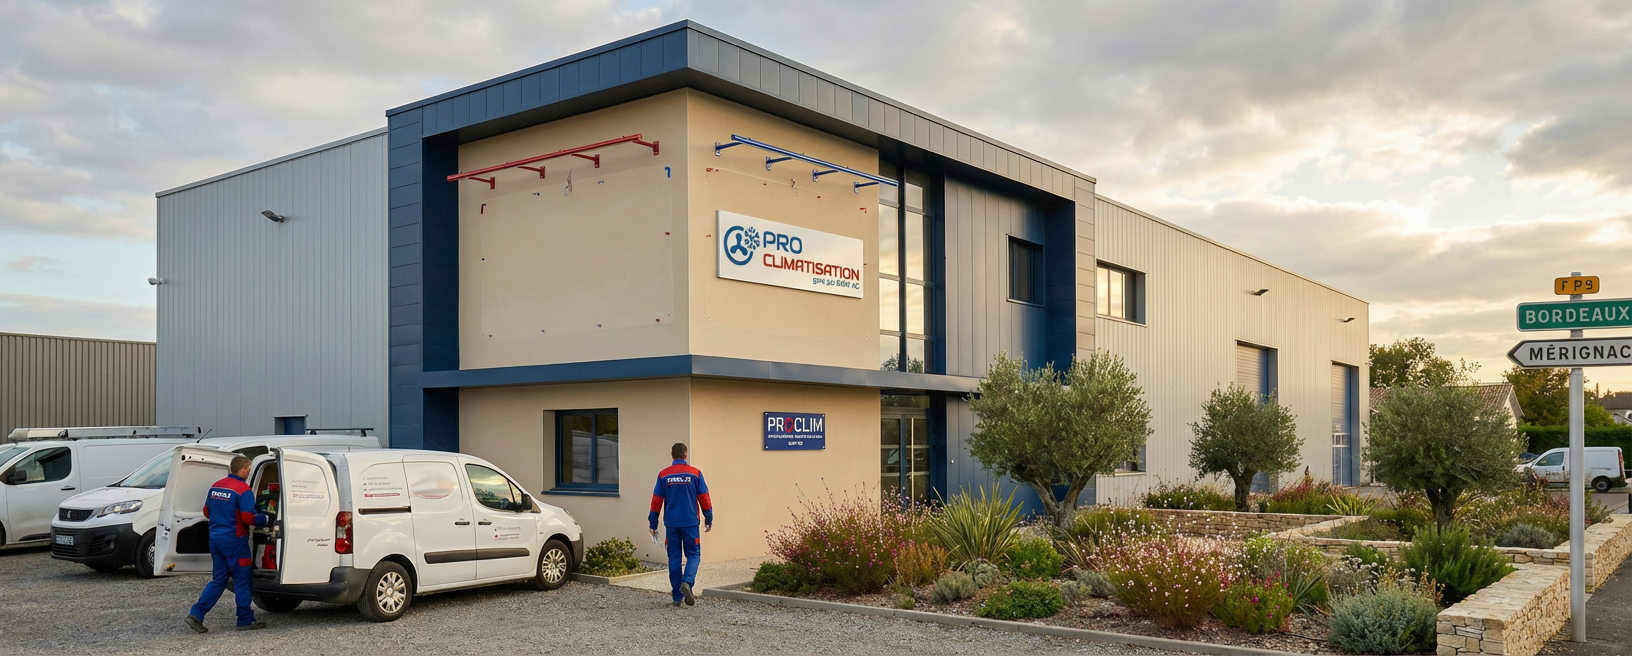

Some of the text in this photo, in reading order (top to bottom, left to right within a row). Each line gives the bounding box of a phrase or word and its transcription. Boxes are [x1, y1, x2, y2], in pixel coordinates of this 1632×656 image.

[763, 231, 802, 254] PRO
[763, 253, 860, 281] CLIMATISATION
[1525, 306, 1630, 324] BORDEAUX
[1529, 344, 1631, 361] MÉRIGNAC
[767, 417, 823, 433] PROCLIM
